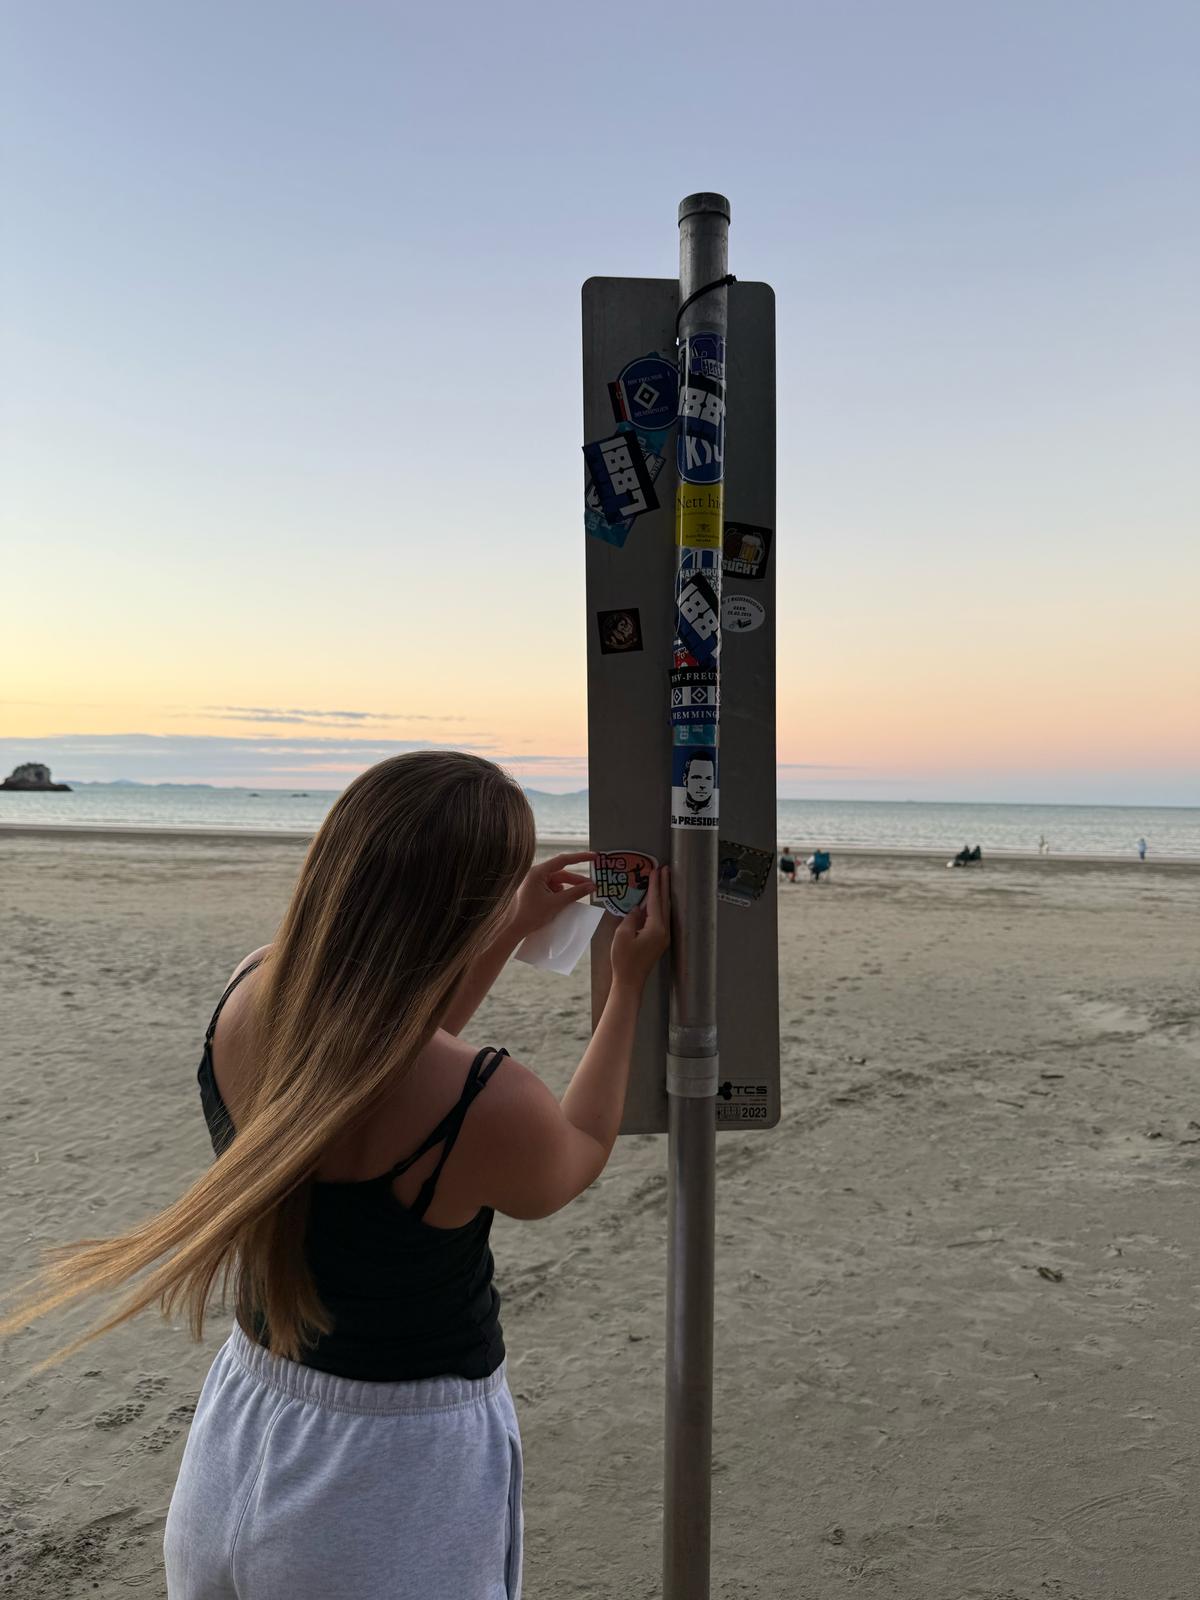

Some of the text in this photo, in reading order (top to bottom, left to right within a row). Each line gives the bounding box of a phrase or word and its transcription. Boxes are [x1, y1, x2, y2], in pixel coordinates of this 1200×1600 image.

[677, 496, 704, 508] Nett
[595, 854, 626, 870] live
[597, 869, 628, 884] like
[733, 1086, 768, 1095] TCS
[742, 1107, 767, 1118] 2023
